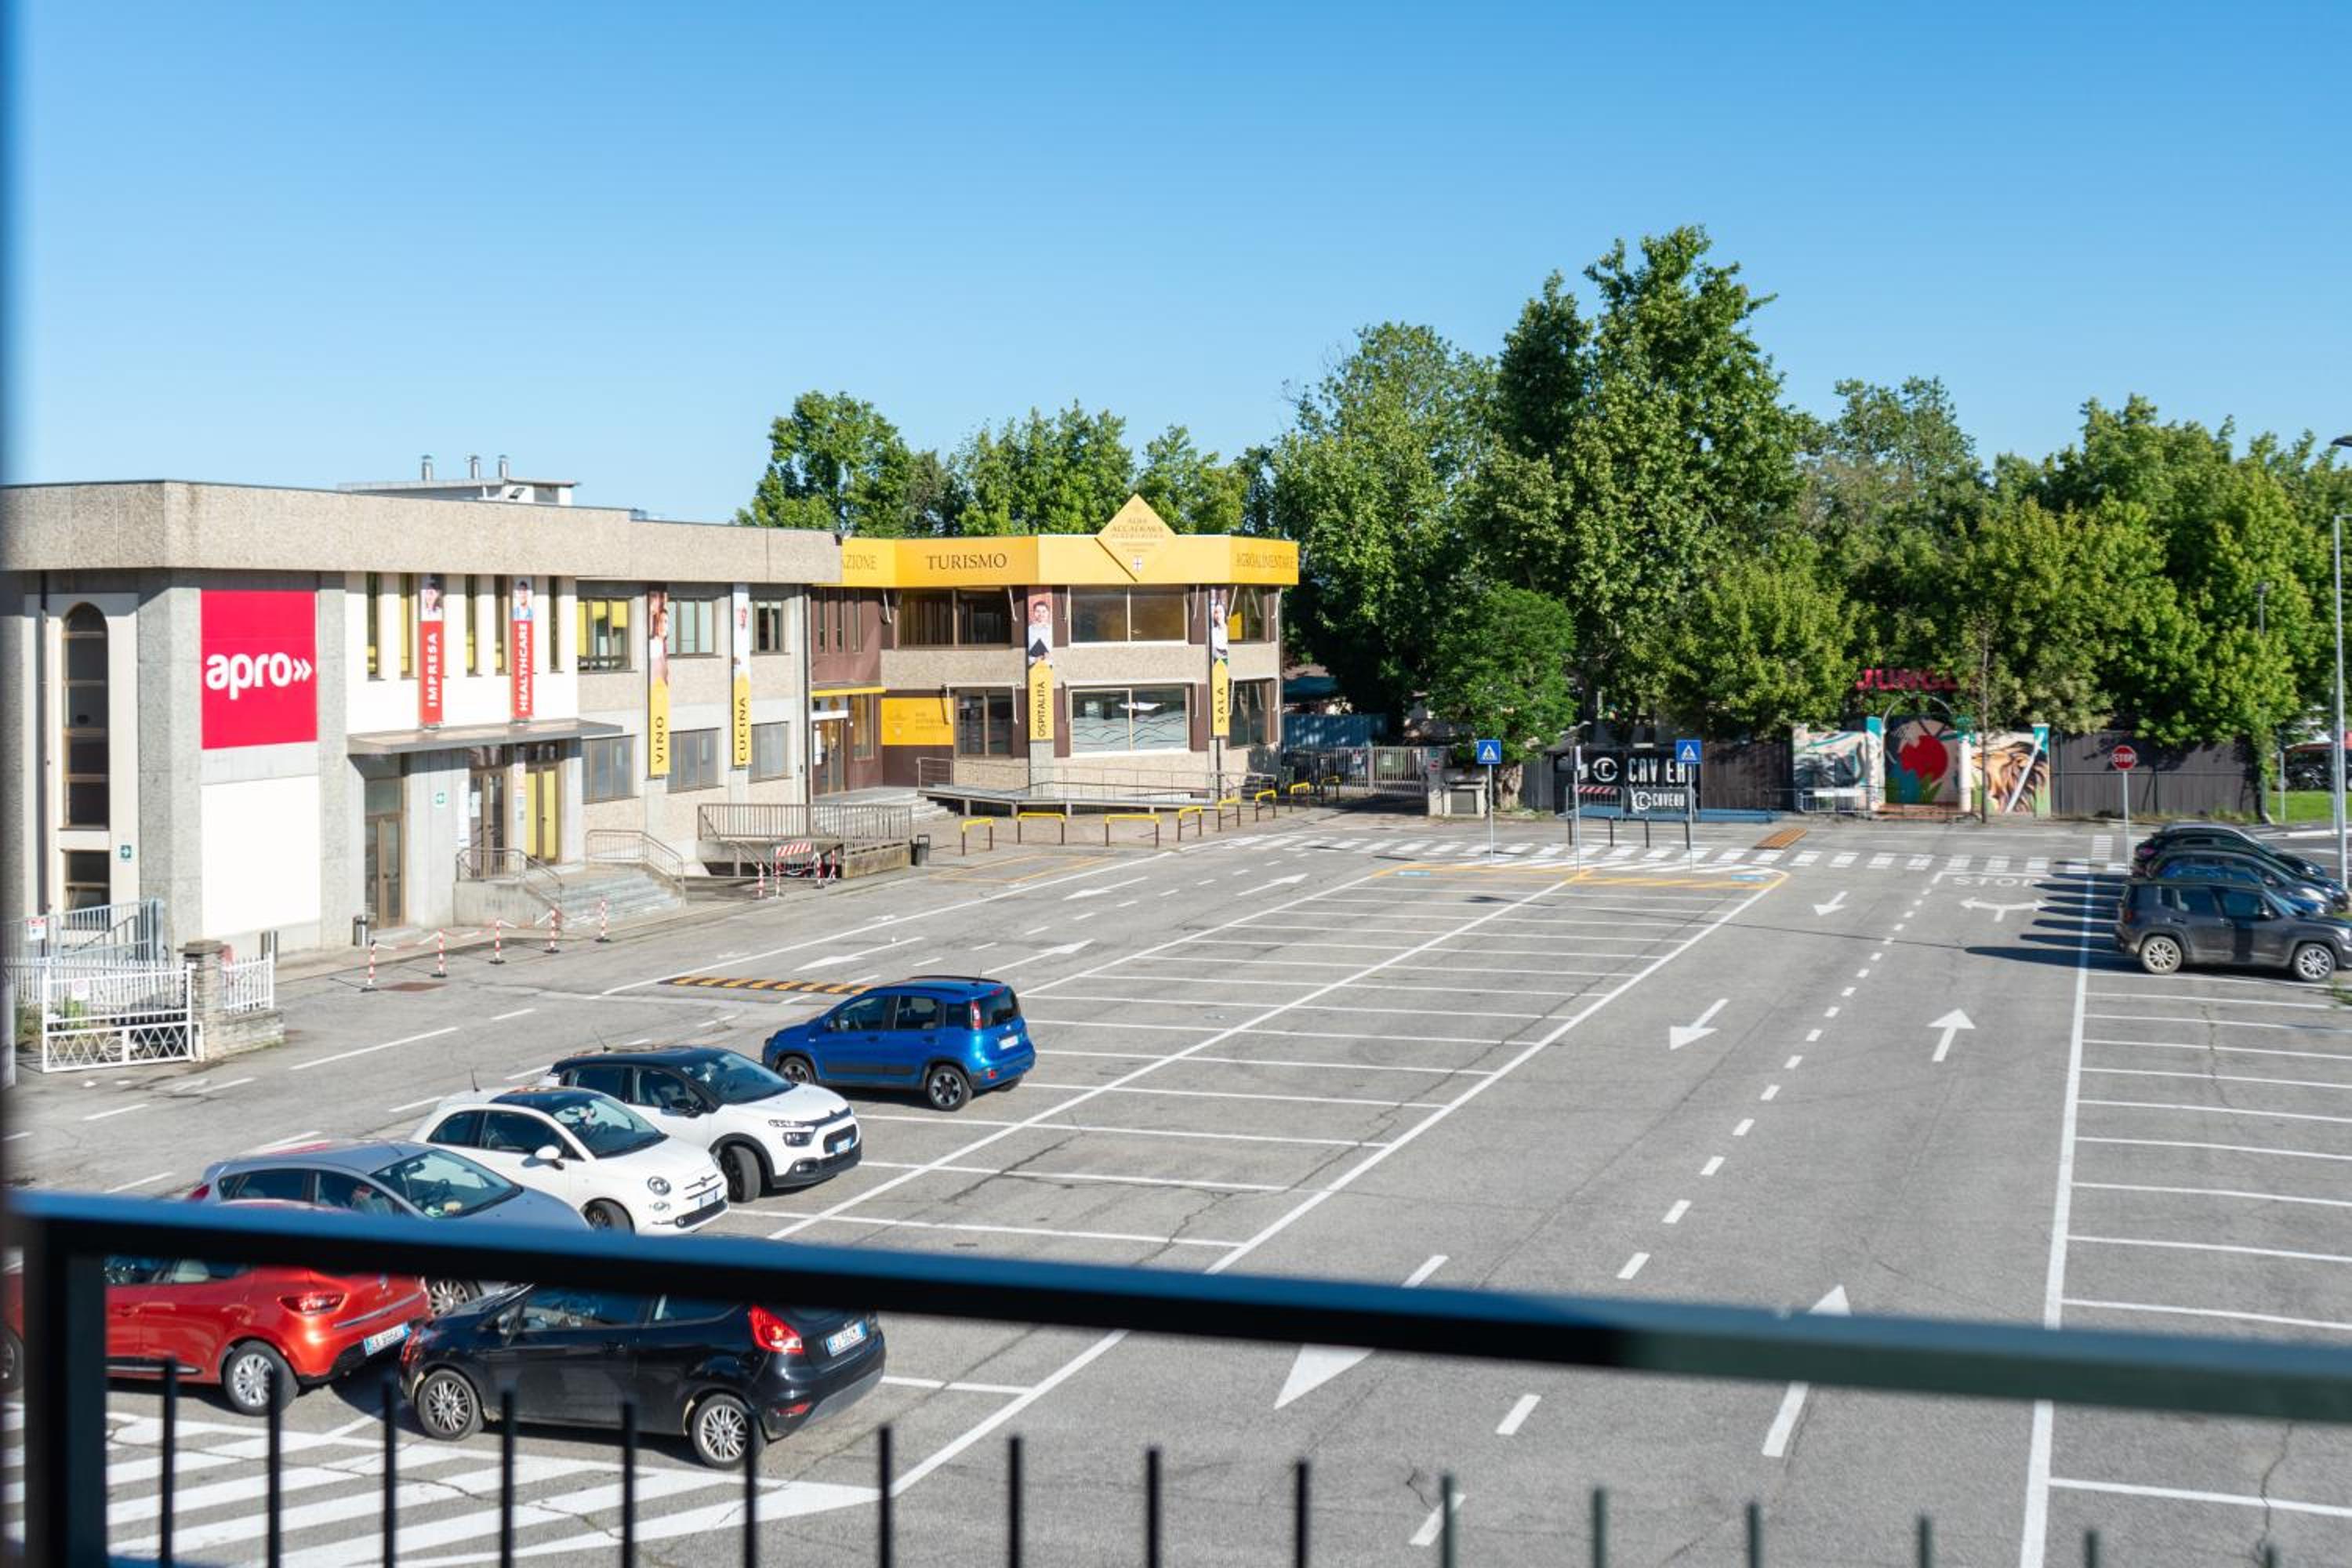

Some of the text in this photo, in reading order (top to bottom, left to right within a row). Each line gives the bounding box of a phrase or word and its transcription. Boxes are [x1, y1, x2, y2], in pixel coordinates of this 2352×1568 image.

[925, 553, 1007, 570] TURISMO
[426, 632, 437, 708] IMPRESA
[517, 622, 528, 711] HEALTHCARE
[739, 697, 747, 762] CUCINA
[1217, 687, 1225, 724] SALA
[655, 715, 665, 765] VINO
